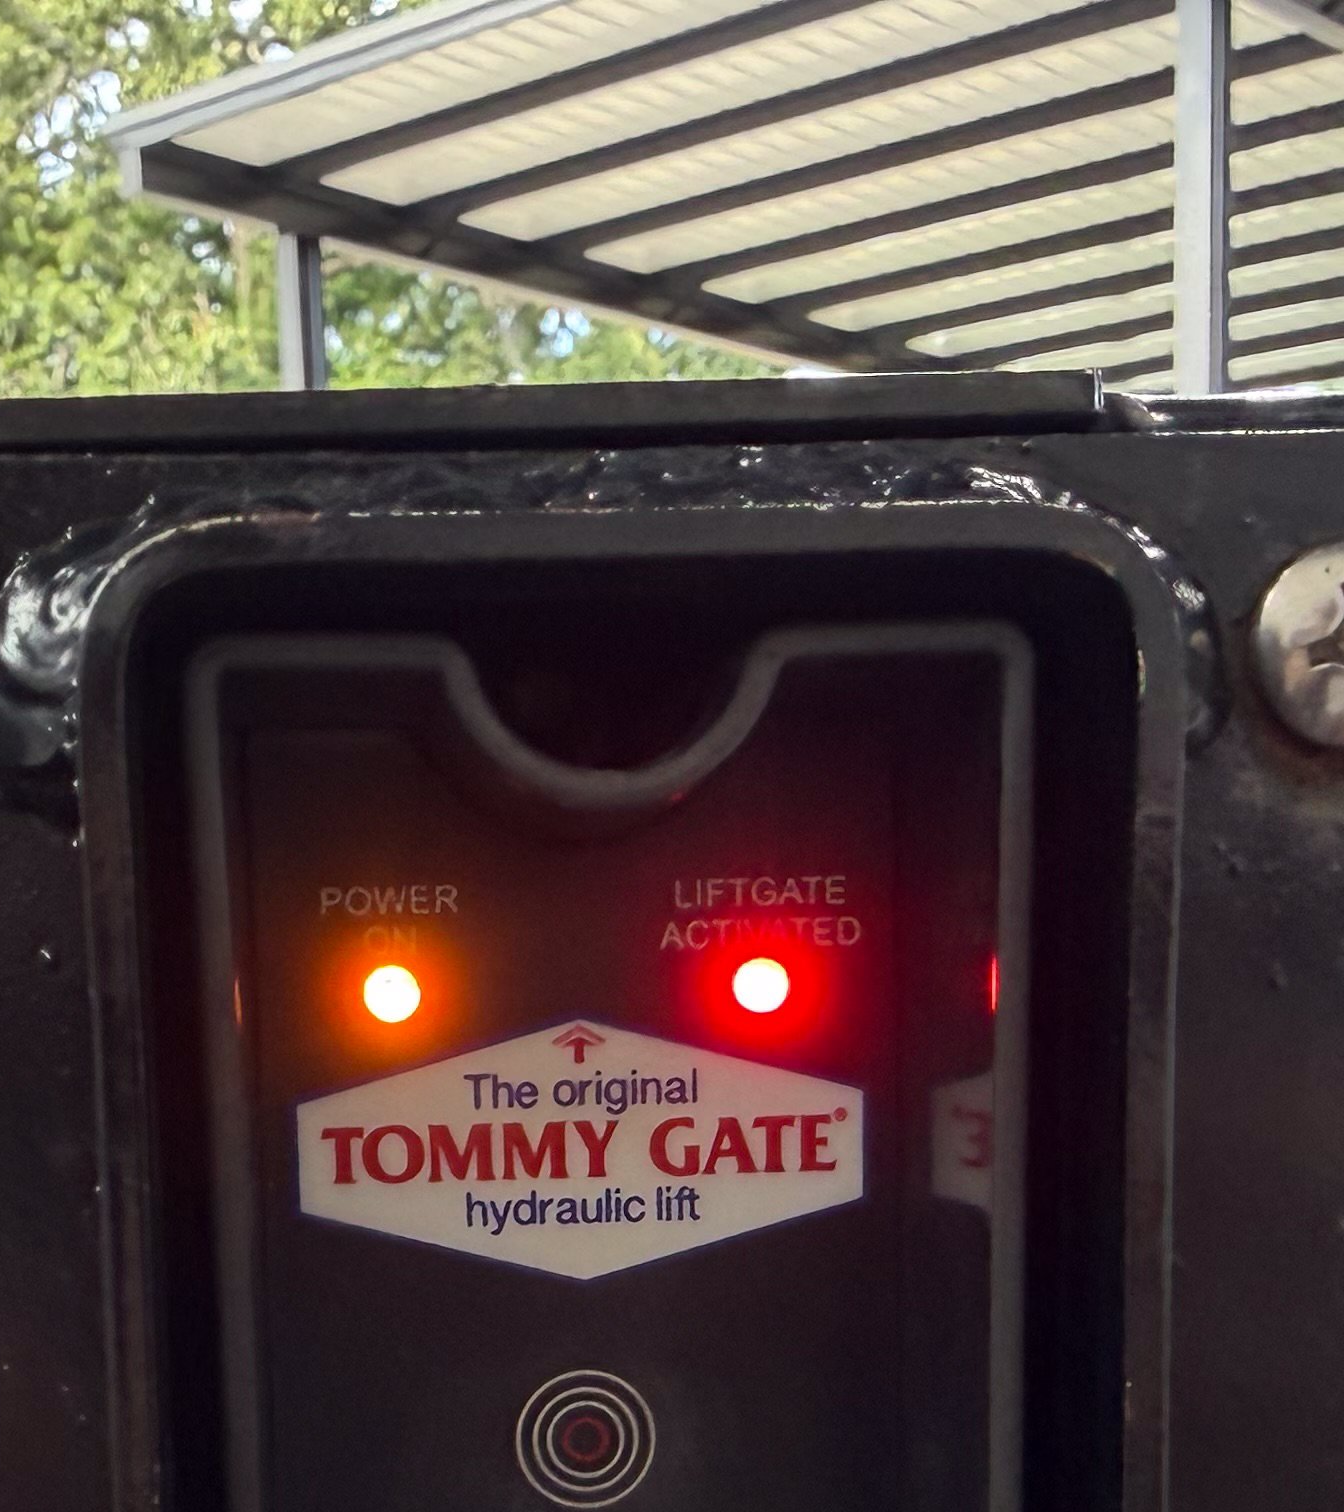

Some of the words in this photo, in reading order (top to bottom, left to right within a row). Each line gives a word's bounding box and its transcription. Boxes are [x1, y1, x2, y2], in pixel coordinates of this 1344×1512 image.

[319, 884, 459, 916] POWER
[674, 875, 846, 909] LIFTGATE
[465, 1073, 539, 1110] The
[553, 1068, 699, 1115] original
[321, 1119, 620, 1185] TOMMY
[465, 1191, 646, 1236] hydraulic
[656, 1186, 701, 1222] lift
